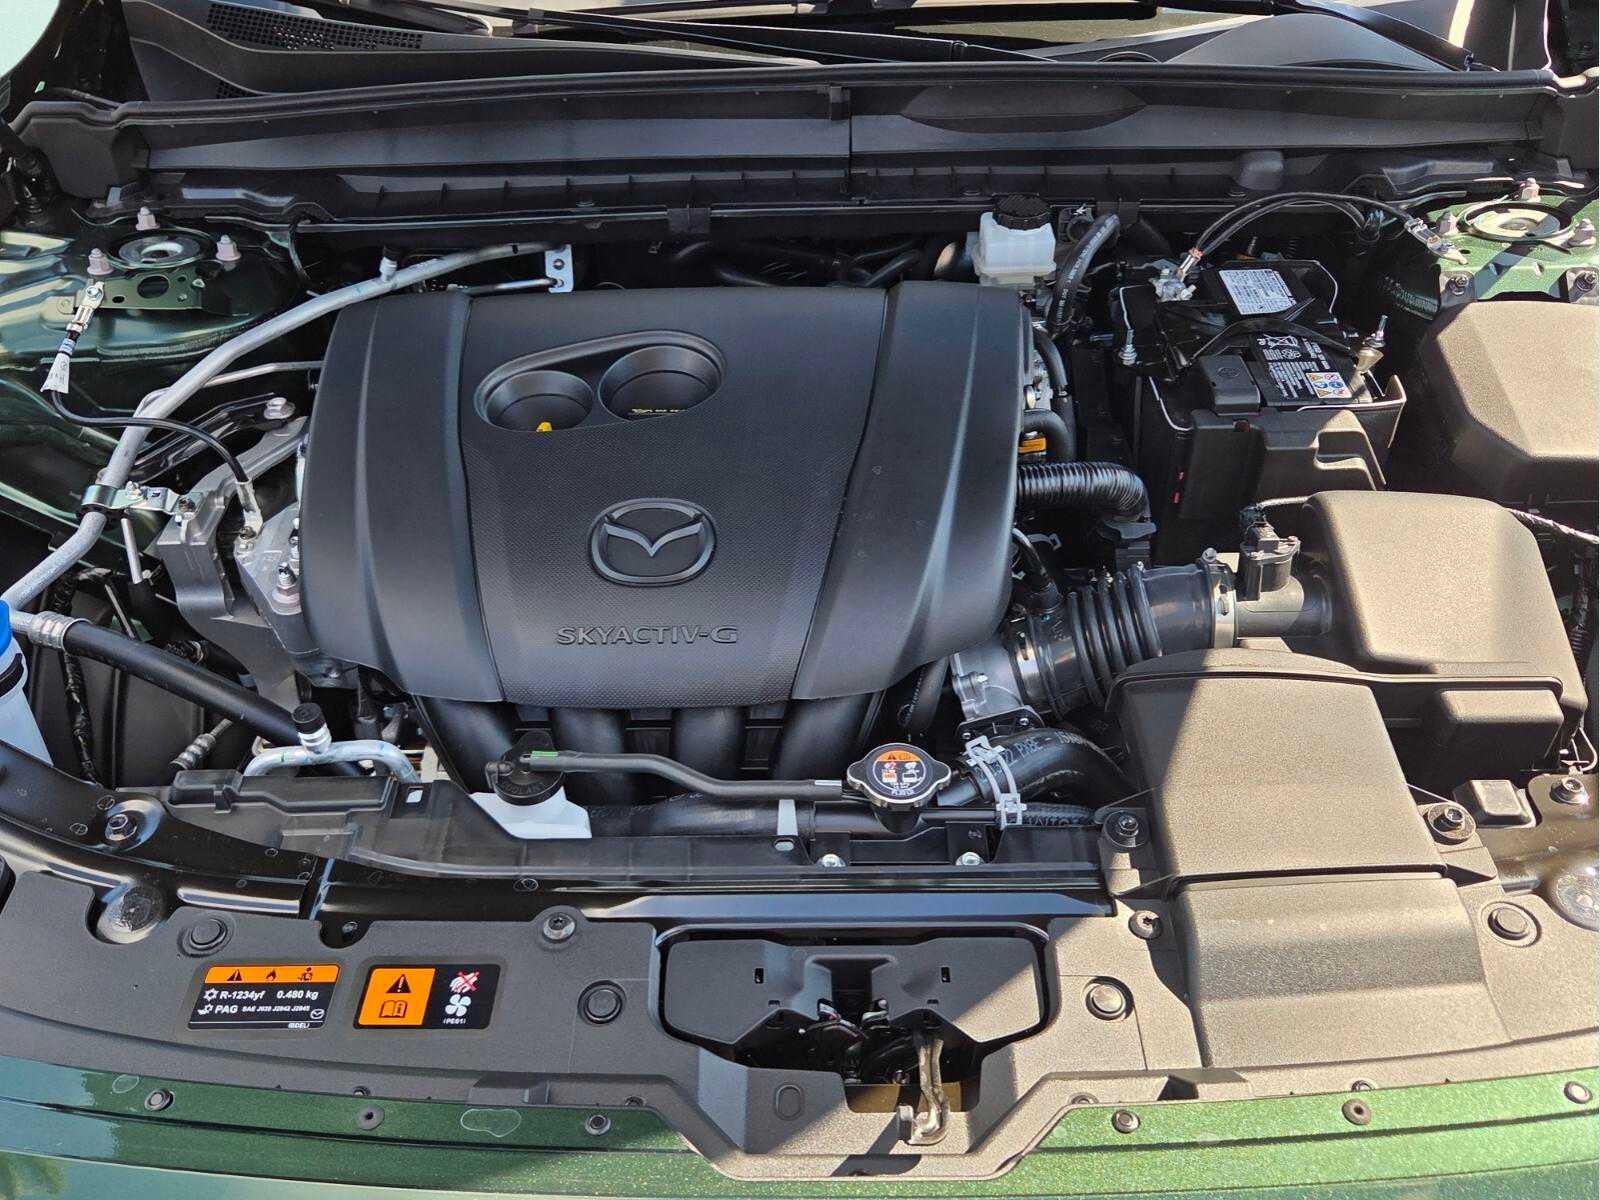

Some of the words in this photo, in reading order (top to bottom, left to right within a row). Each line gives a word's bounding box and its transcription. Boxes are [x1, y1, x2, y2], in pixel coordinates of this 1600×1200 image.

[556, 625, 738, 646] SKYACTIV-G
[220, 990, 265, 1000] R-1234yf
[276, 990, 304, 999] 0.480
[305, 990, 319, 1000] kg
[215, 1004, 239, 1014] PAG
